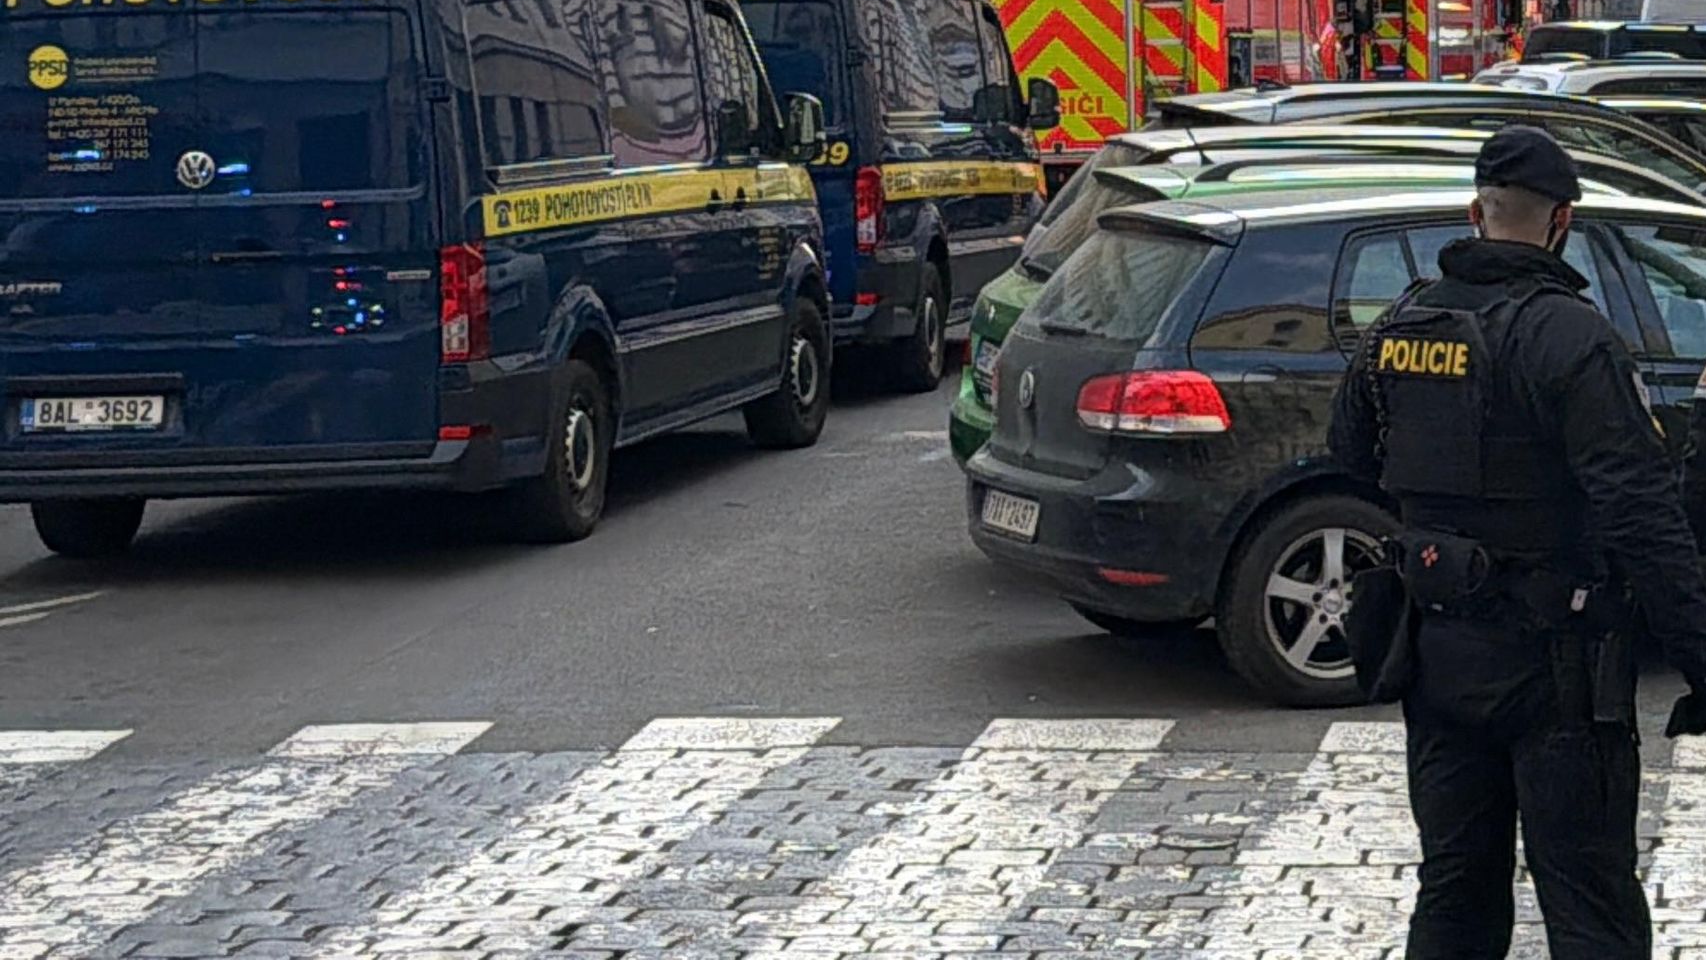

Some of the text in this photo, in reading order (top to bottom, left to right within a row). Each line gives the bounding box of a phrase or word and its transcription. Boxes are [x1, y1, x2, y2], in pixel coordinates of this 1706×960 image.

[1058, 91, 1103, 115] IČI
[1379, 338, 1469, 376] POLICIE
[39, 399, 154, 424] 8AL 3692
